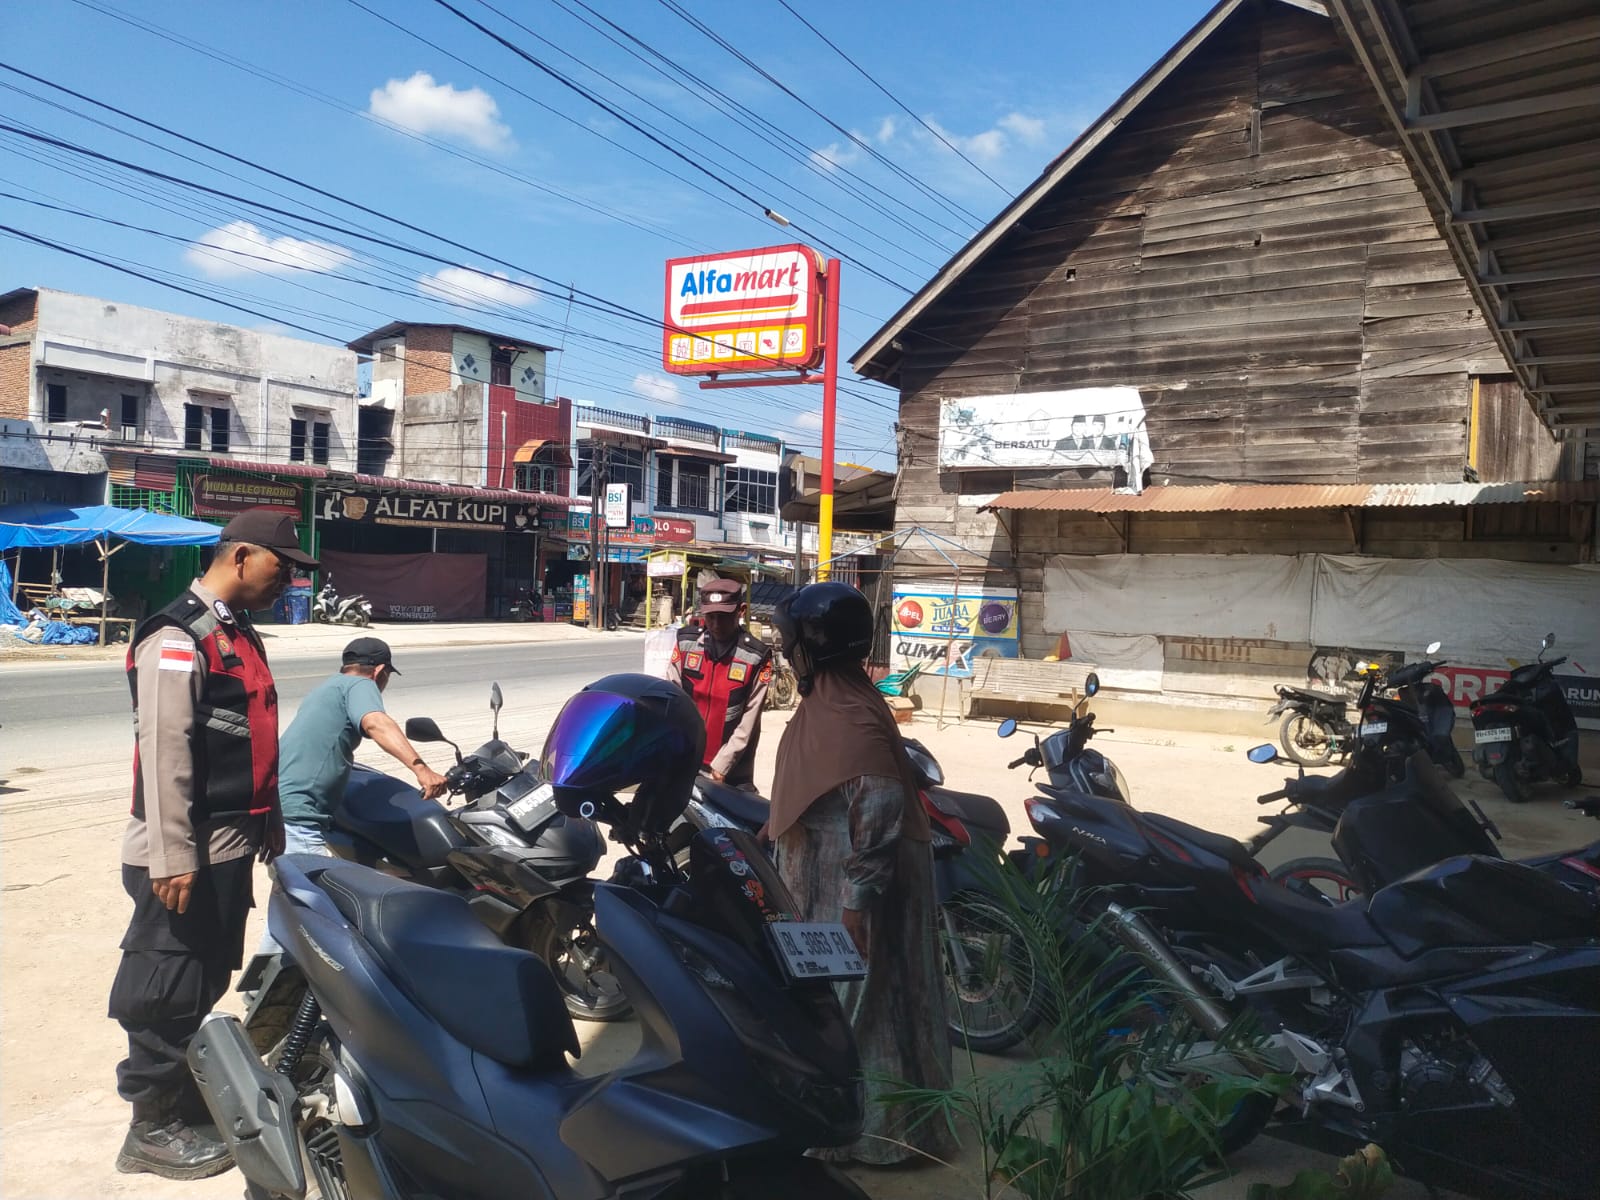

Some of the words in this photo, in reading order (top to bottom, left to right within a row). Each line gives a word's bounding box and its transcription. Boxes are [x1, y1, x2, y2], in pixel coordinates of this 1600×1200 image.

[680, 262, 801, 297] Alfamart
[994, 440, 1050, 449] BERSATU
[235, 484, 297, 497] ELECTRONIC
[608, 492, 622, 503] BSI
[374, 496, 452, 520] ALFAT
[456, 502, 508, 523] KUPI
[572, 517, 585, 527] BSI
[899, 606, 921, 621] APEL
[932, 604, 970, 621] JUARA
[983, 613, 1006, 624] BERRY
[780, 931, 804, 956] BL
